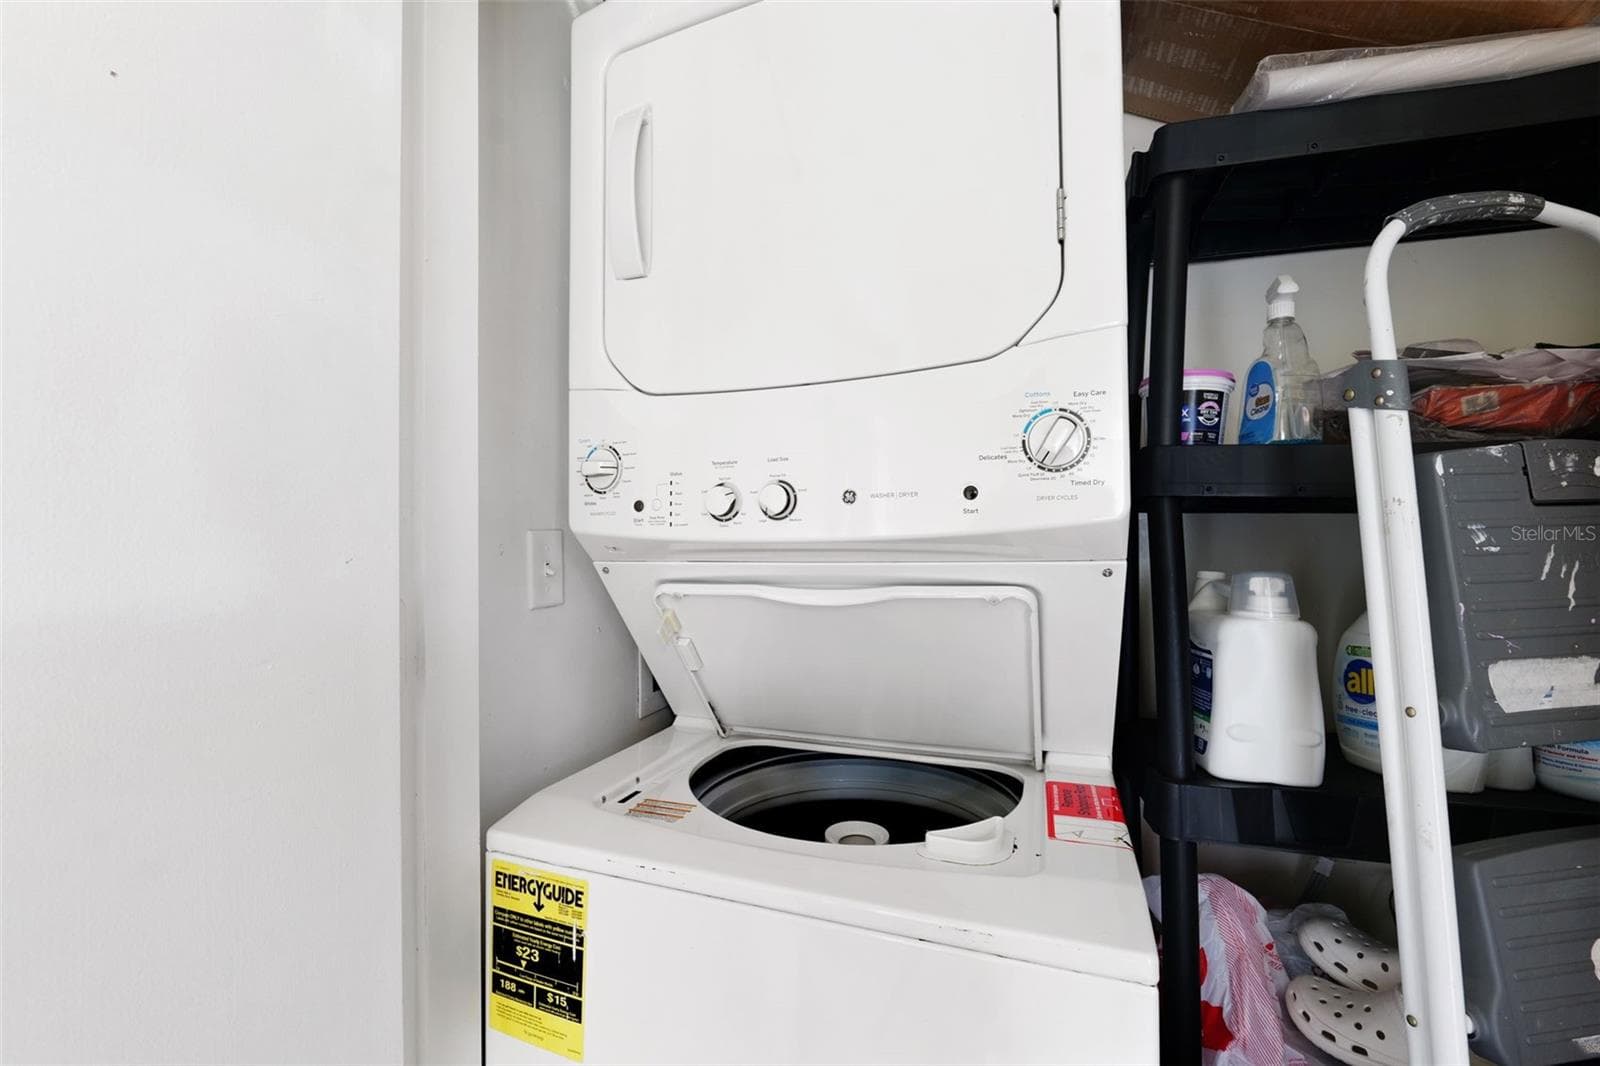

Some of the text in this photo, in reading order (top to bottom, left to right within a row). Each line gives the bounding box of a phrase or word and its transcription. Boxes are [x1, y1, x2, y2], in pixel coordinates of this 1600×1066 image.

[1092, 479, 1105, 487] Dry
[1347, 667, 1375, 696] all
[495, 870, 584, 911] ENERGYGUIDE
[515, 945, 540, 962] $23
[499, 979, 516, 993] 188
[546, 992, 567, 1007] $15
